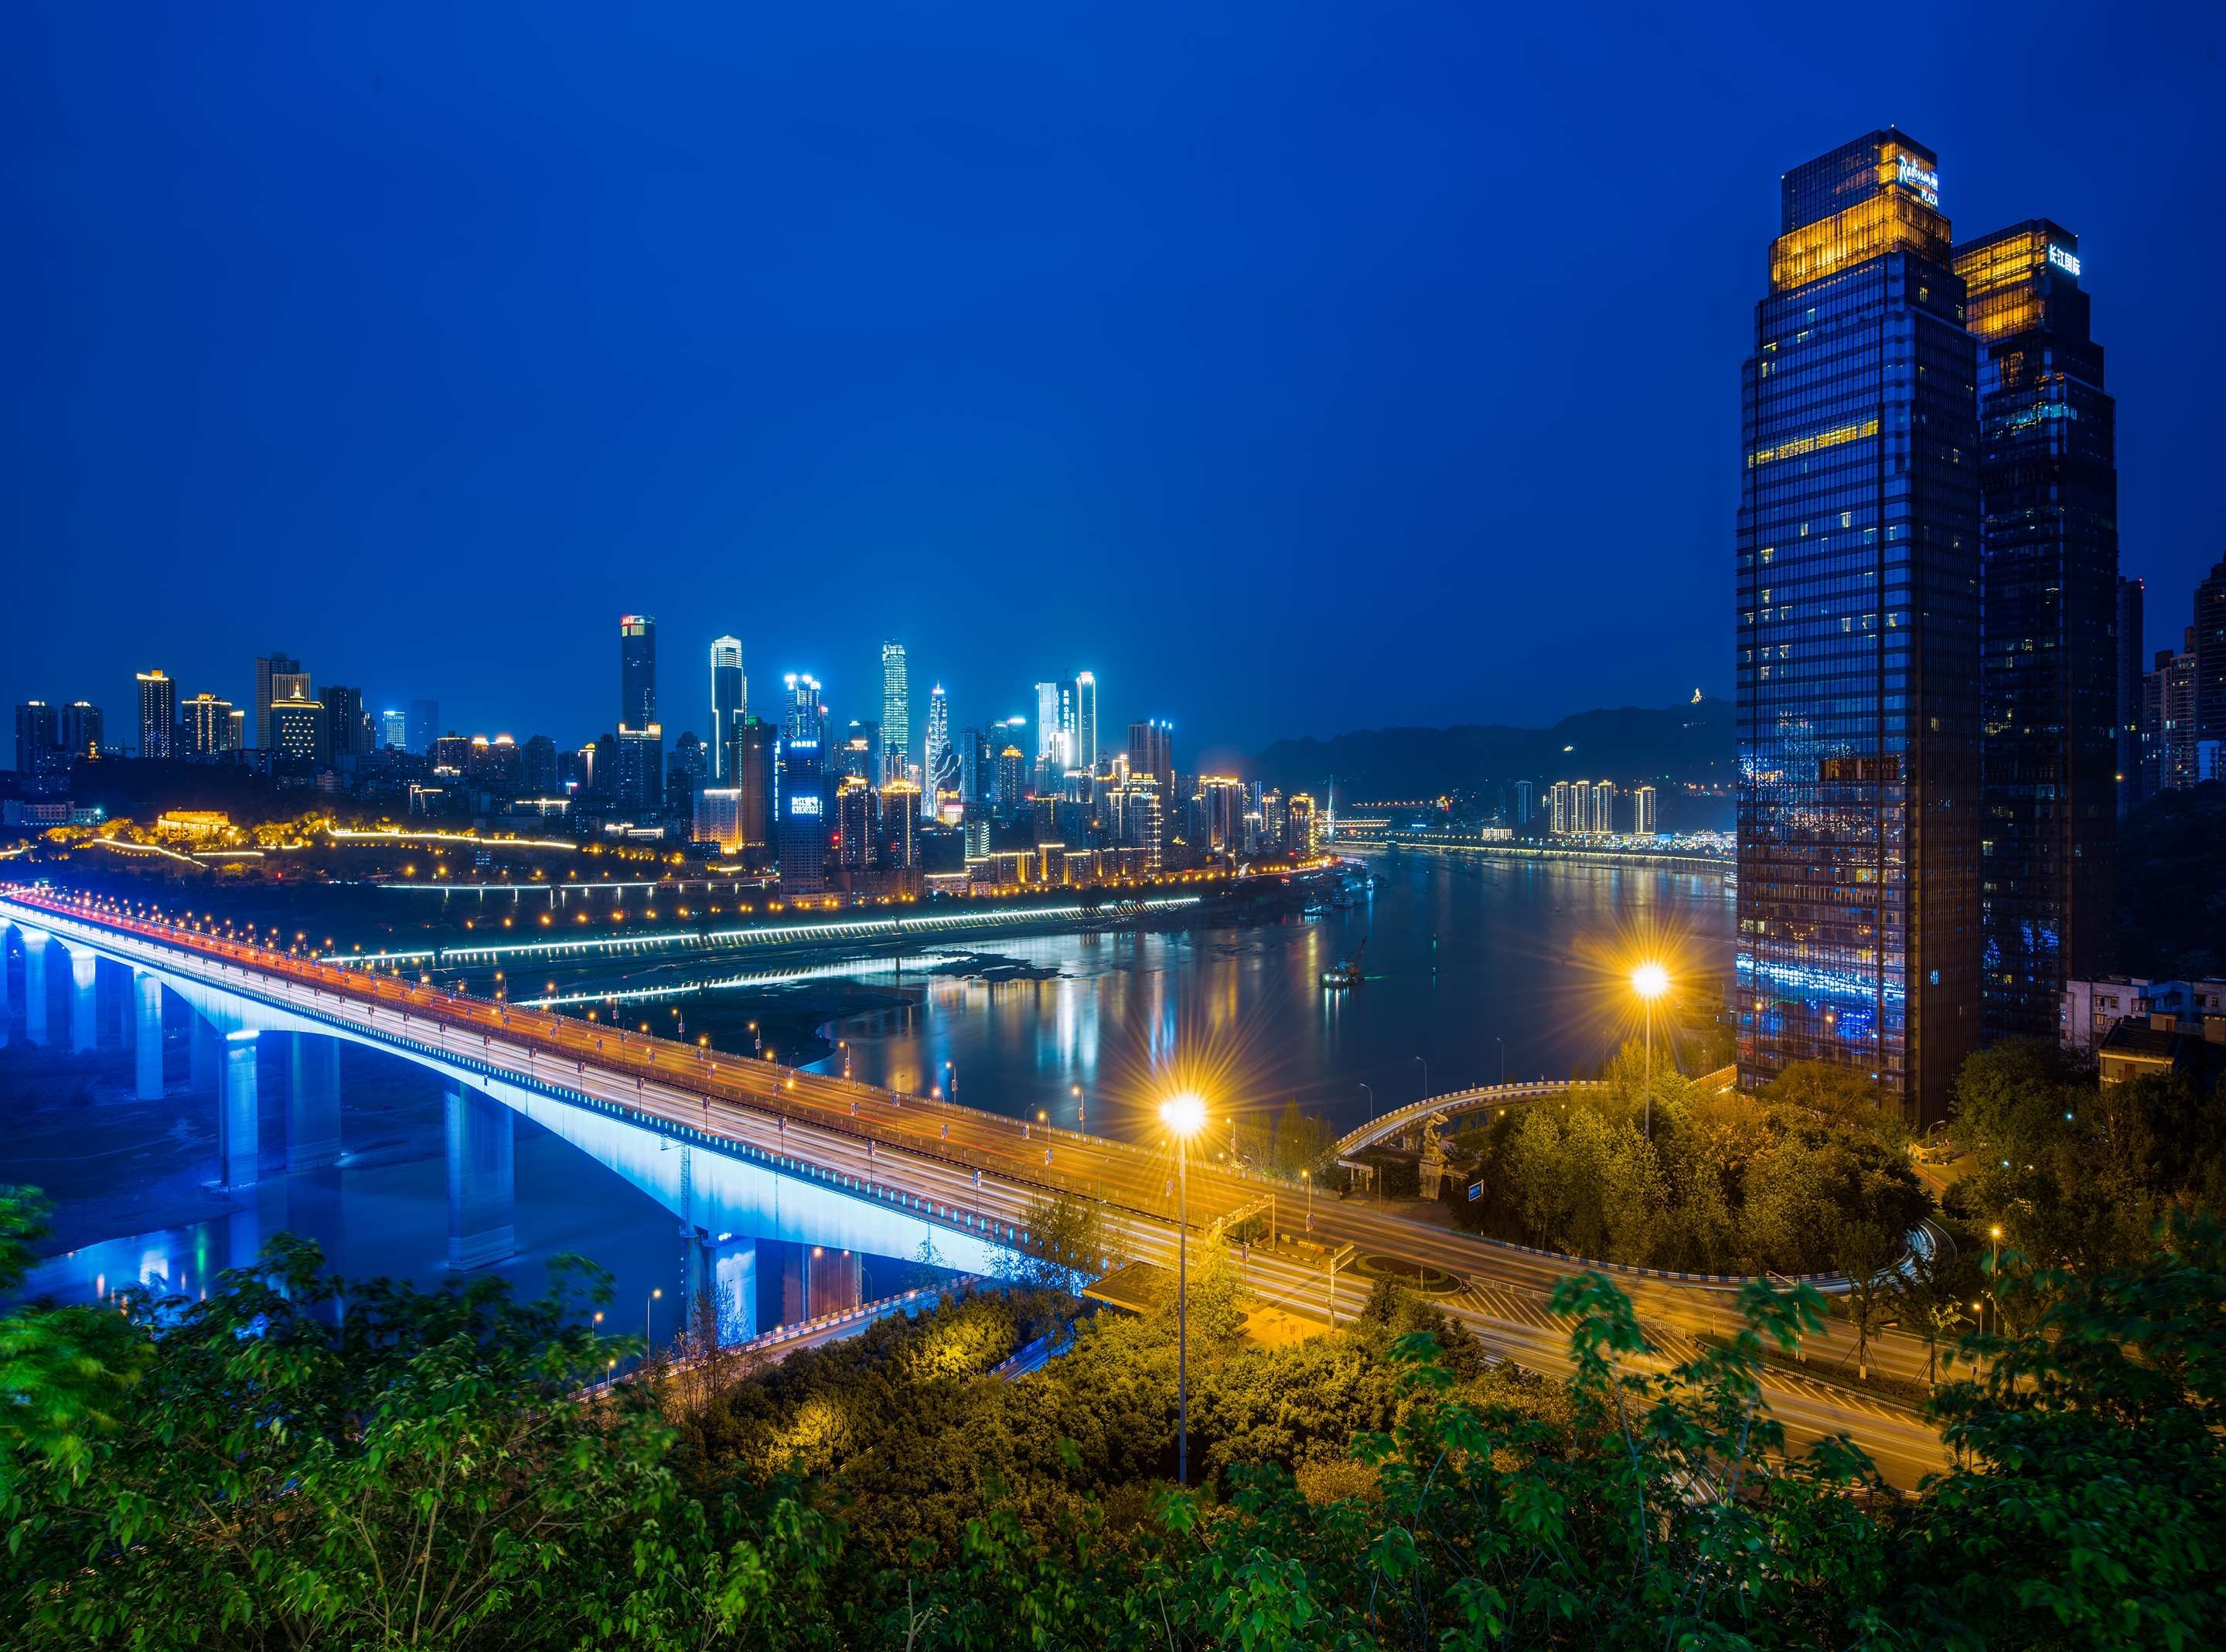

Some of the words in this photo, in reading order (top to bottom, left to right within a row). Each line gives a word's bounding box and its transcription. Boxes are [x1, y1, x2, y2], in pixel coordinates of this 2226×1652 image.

[1921, 189, 1938, 206] PLAZA
[2049, 244, 2081, 275] 长江国际
